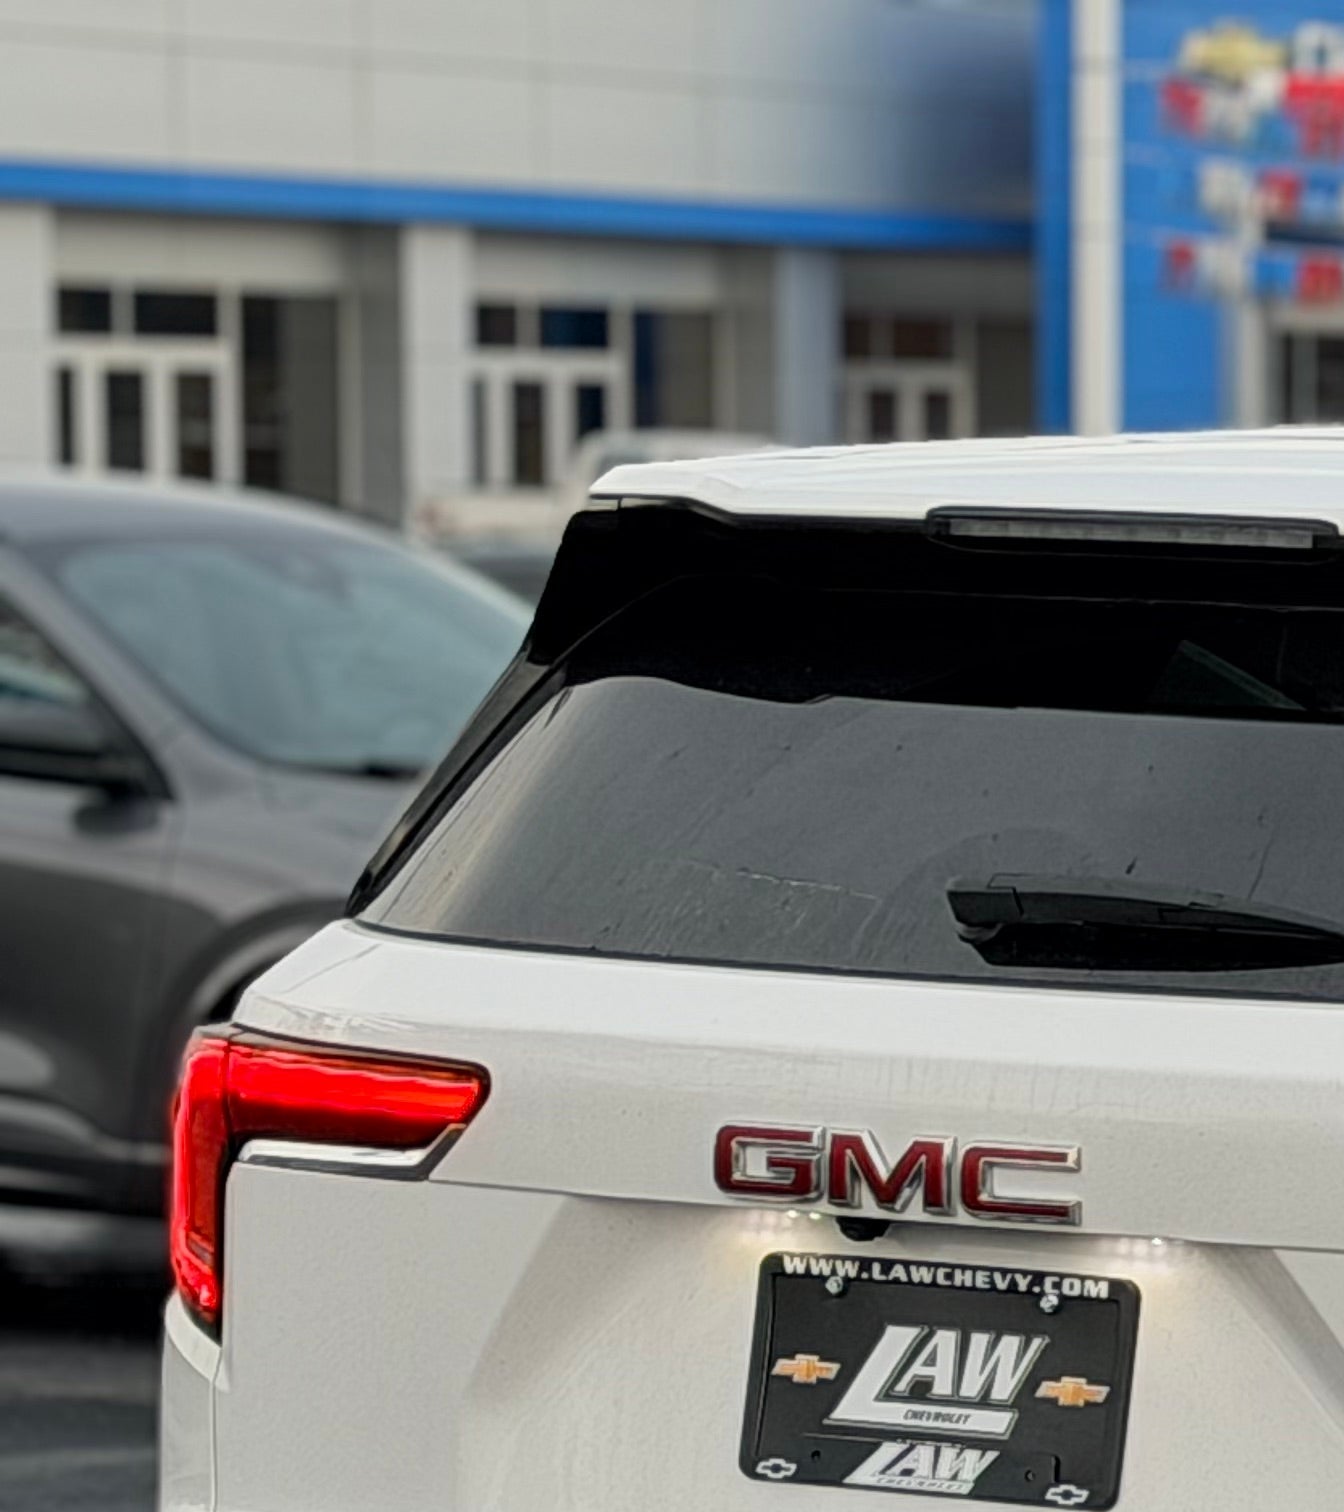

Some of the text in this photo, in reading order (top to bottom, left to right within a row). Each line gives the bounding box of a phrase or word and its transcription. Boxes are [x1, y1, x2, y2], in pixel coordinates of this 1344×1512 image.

[713, 1121, 1082, 1227] GMC
[782, 1254, 1110, 1299] WWW.LAWCHEVY.COM
[823, 1325, 1050, 1440] LAW
[842, 1441, 1001, 1494] LAW
